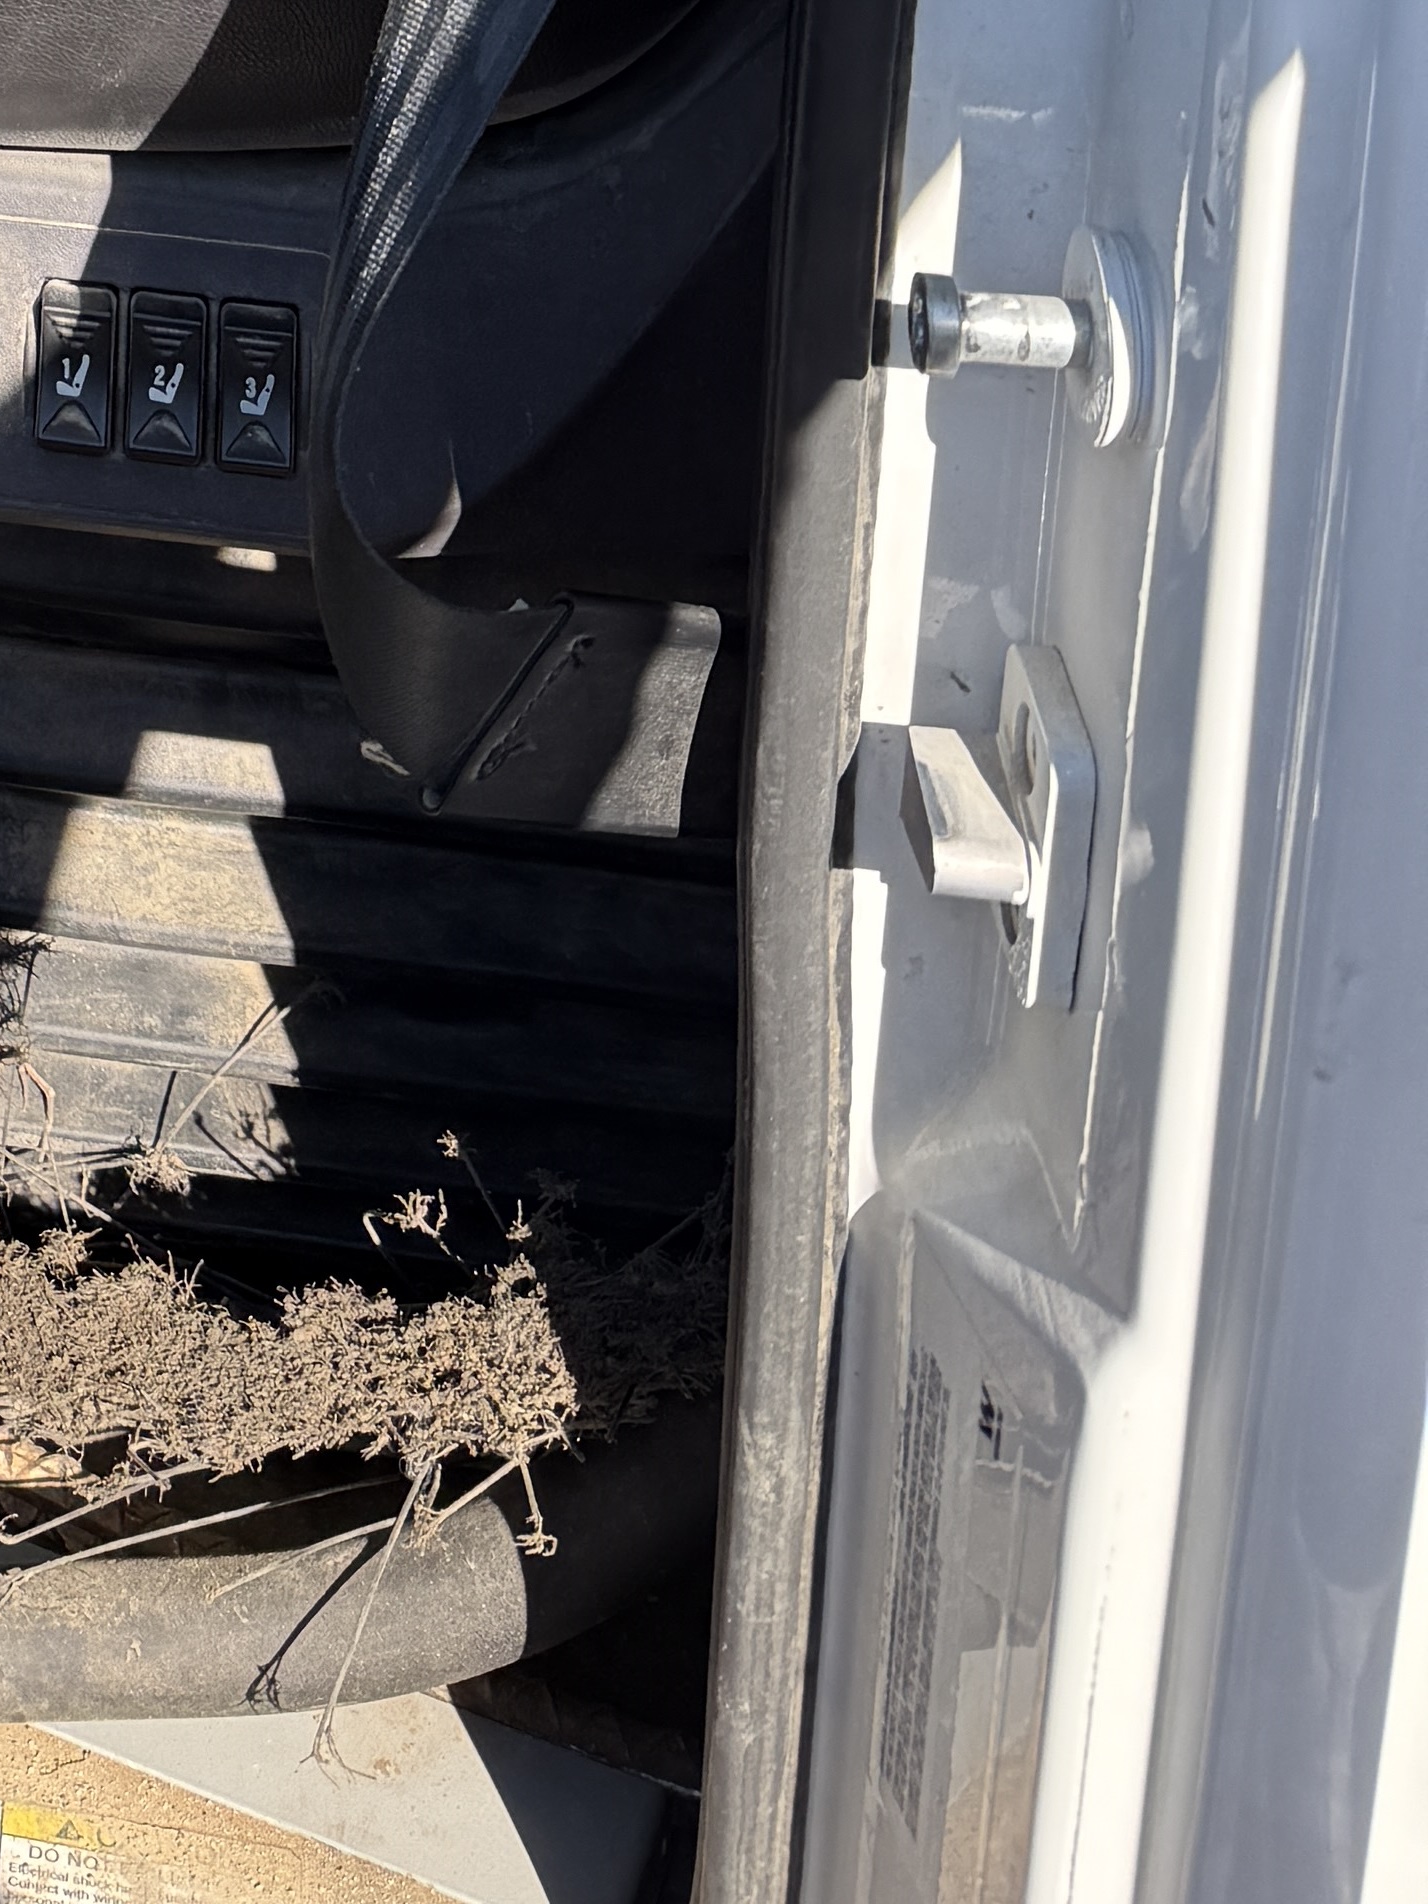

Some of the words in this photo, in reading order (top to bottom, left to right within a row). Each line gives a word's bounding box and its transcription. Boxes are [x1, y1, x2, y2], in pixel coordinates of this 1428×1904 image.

[62, 358, 70, 379] 1
[153, 365, 165, 386] 2
[245, 377, 256, 398] 3
[29, 1845, 60, 1863] DO
